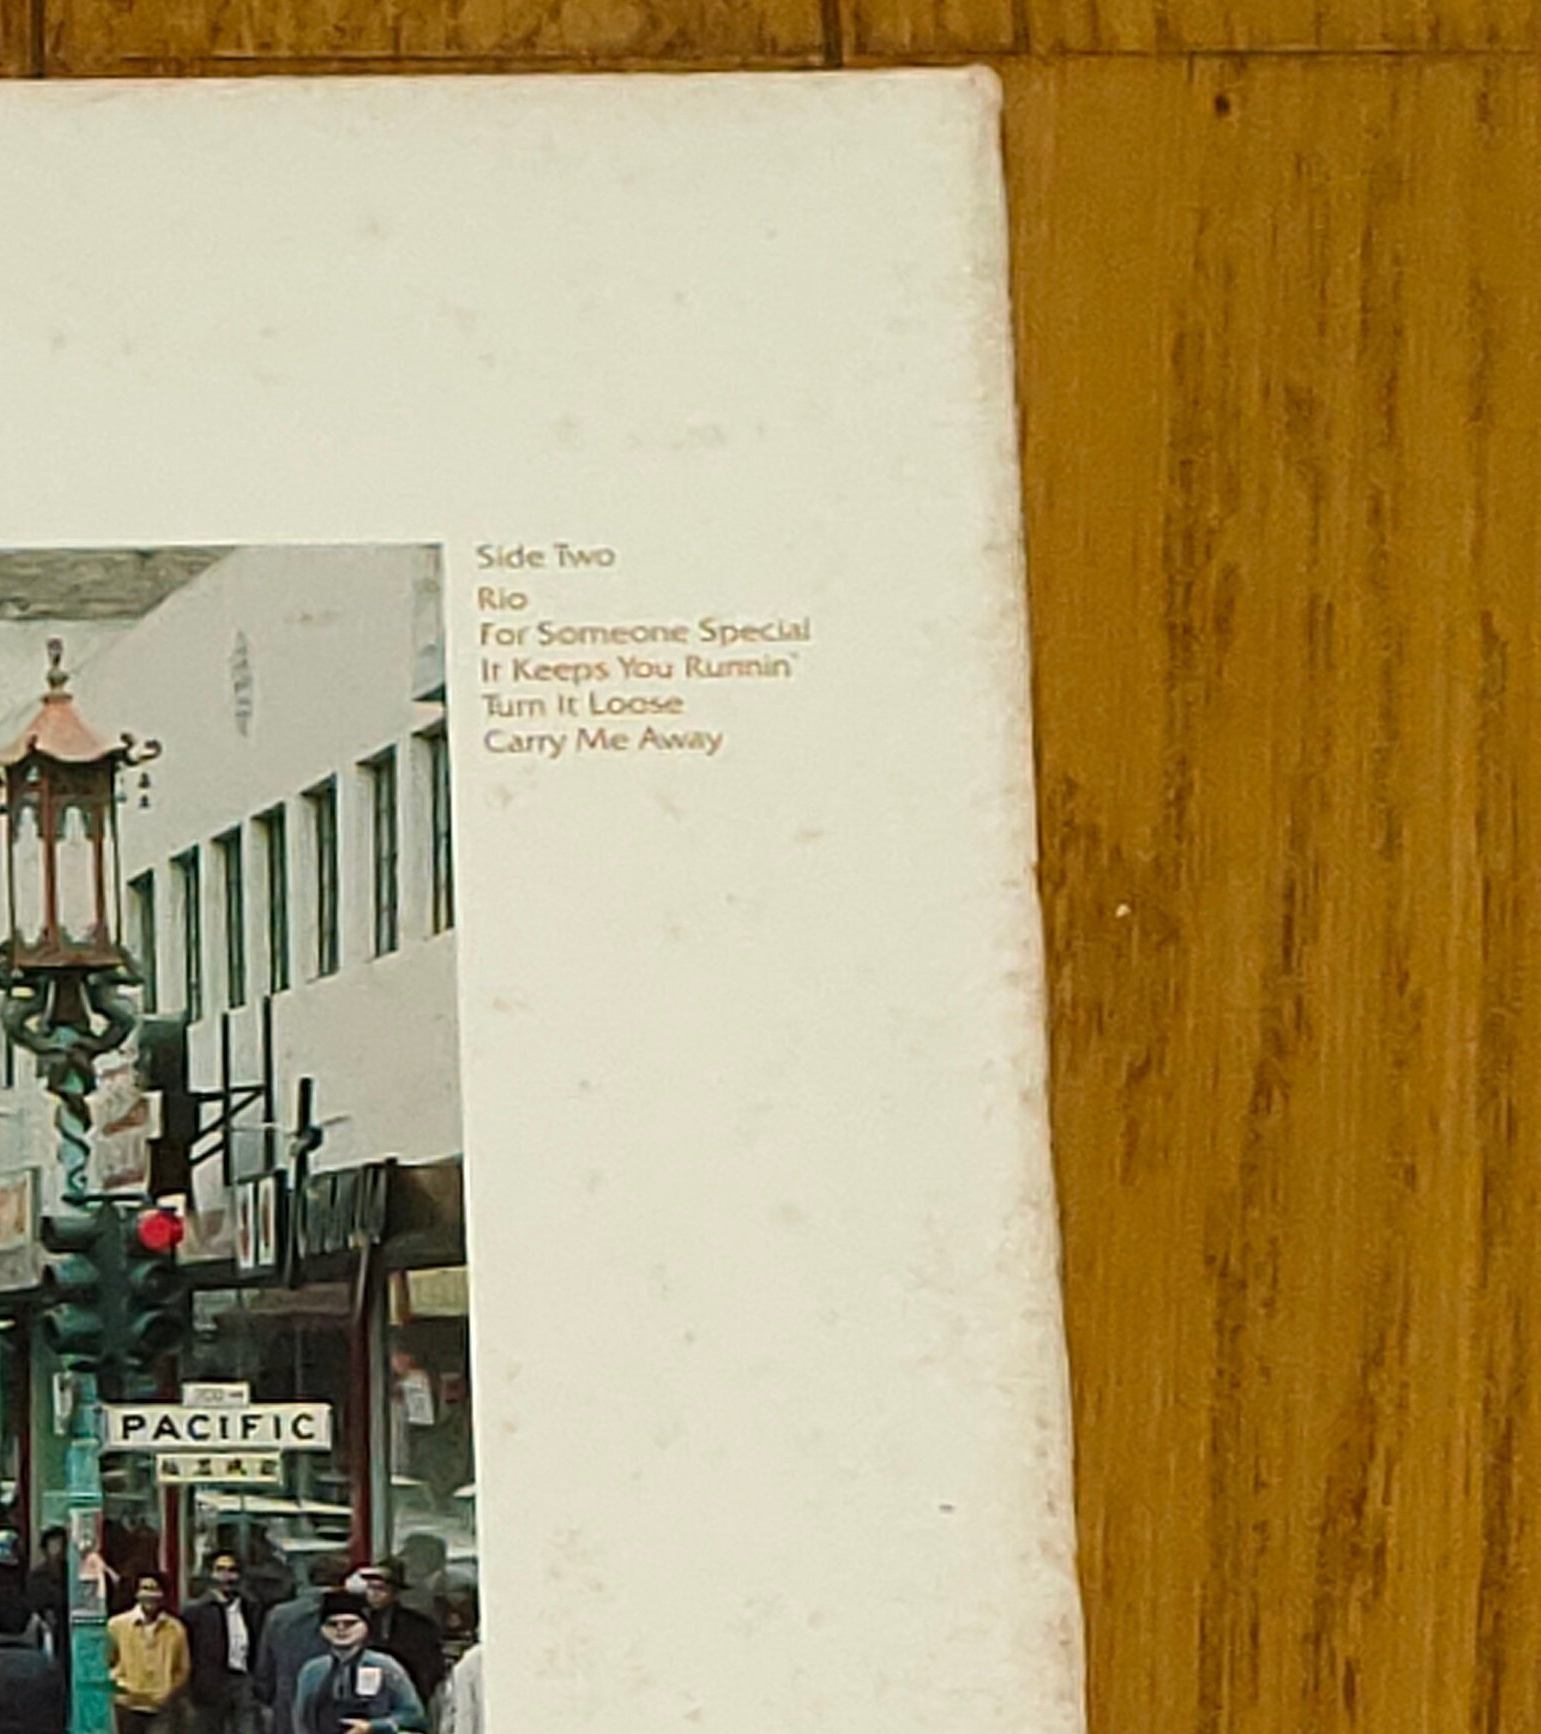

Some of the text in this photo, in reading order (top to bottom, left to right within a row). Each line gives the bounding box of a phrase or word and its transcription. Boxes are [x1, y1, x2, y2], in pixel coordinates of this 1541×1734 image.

[476, 543, 617, 570] Side Two
[476, 586, 530, 612] Rio
[479, 617, 811, 647] For Someone Special
[481, 657, 501, 684] It
[512, 656, 611, 685] Keeps
[617, 655, 674, 679] You
[481, 691, 685, 718] Turn It Loose
[483, 725, 725, 760] Carry Me Away
[121, 1414, 315, 1440] PACIFIC
